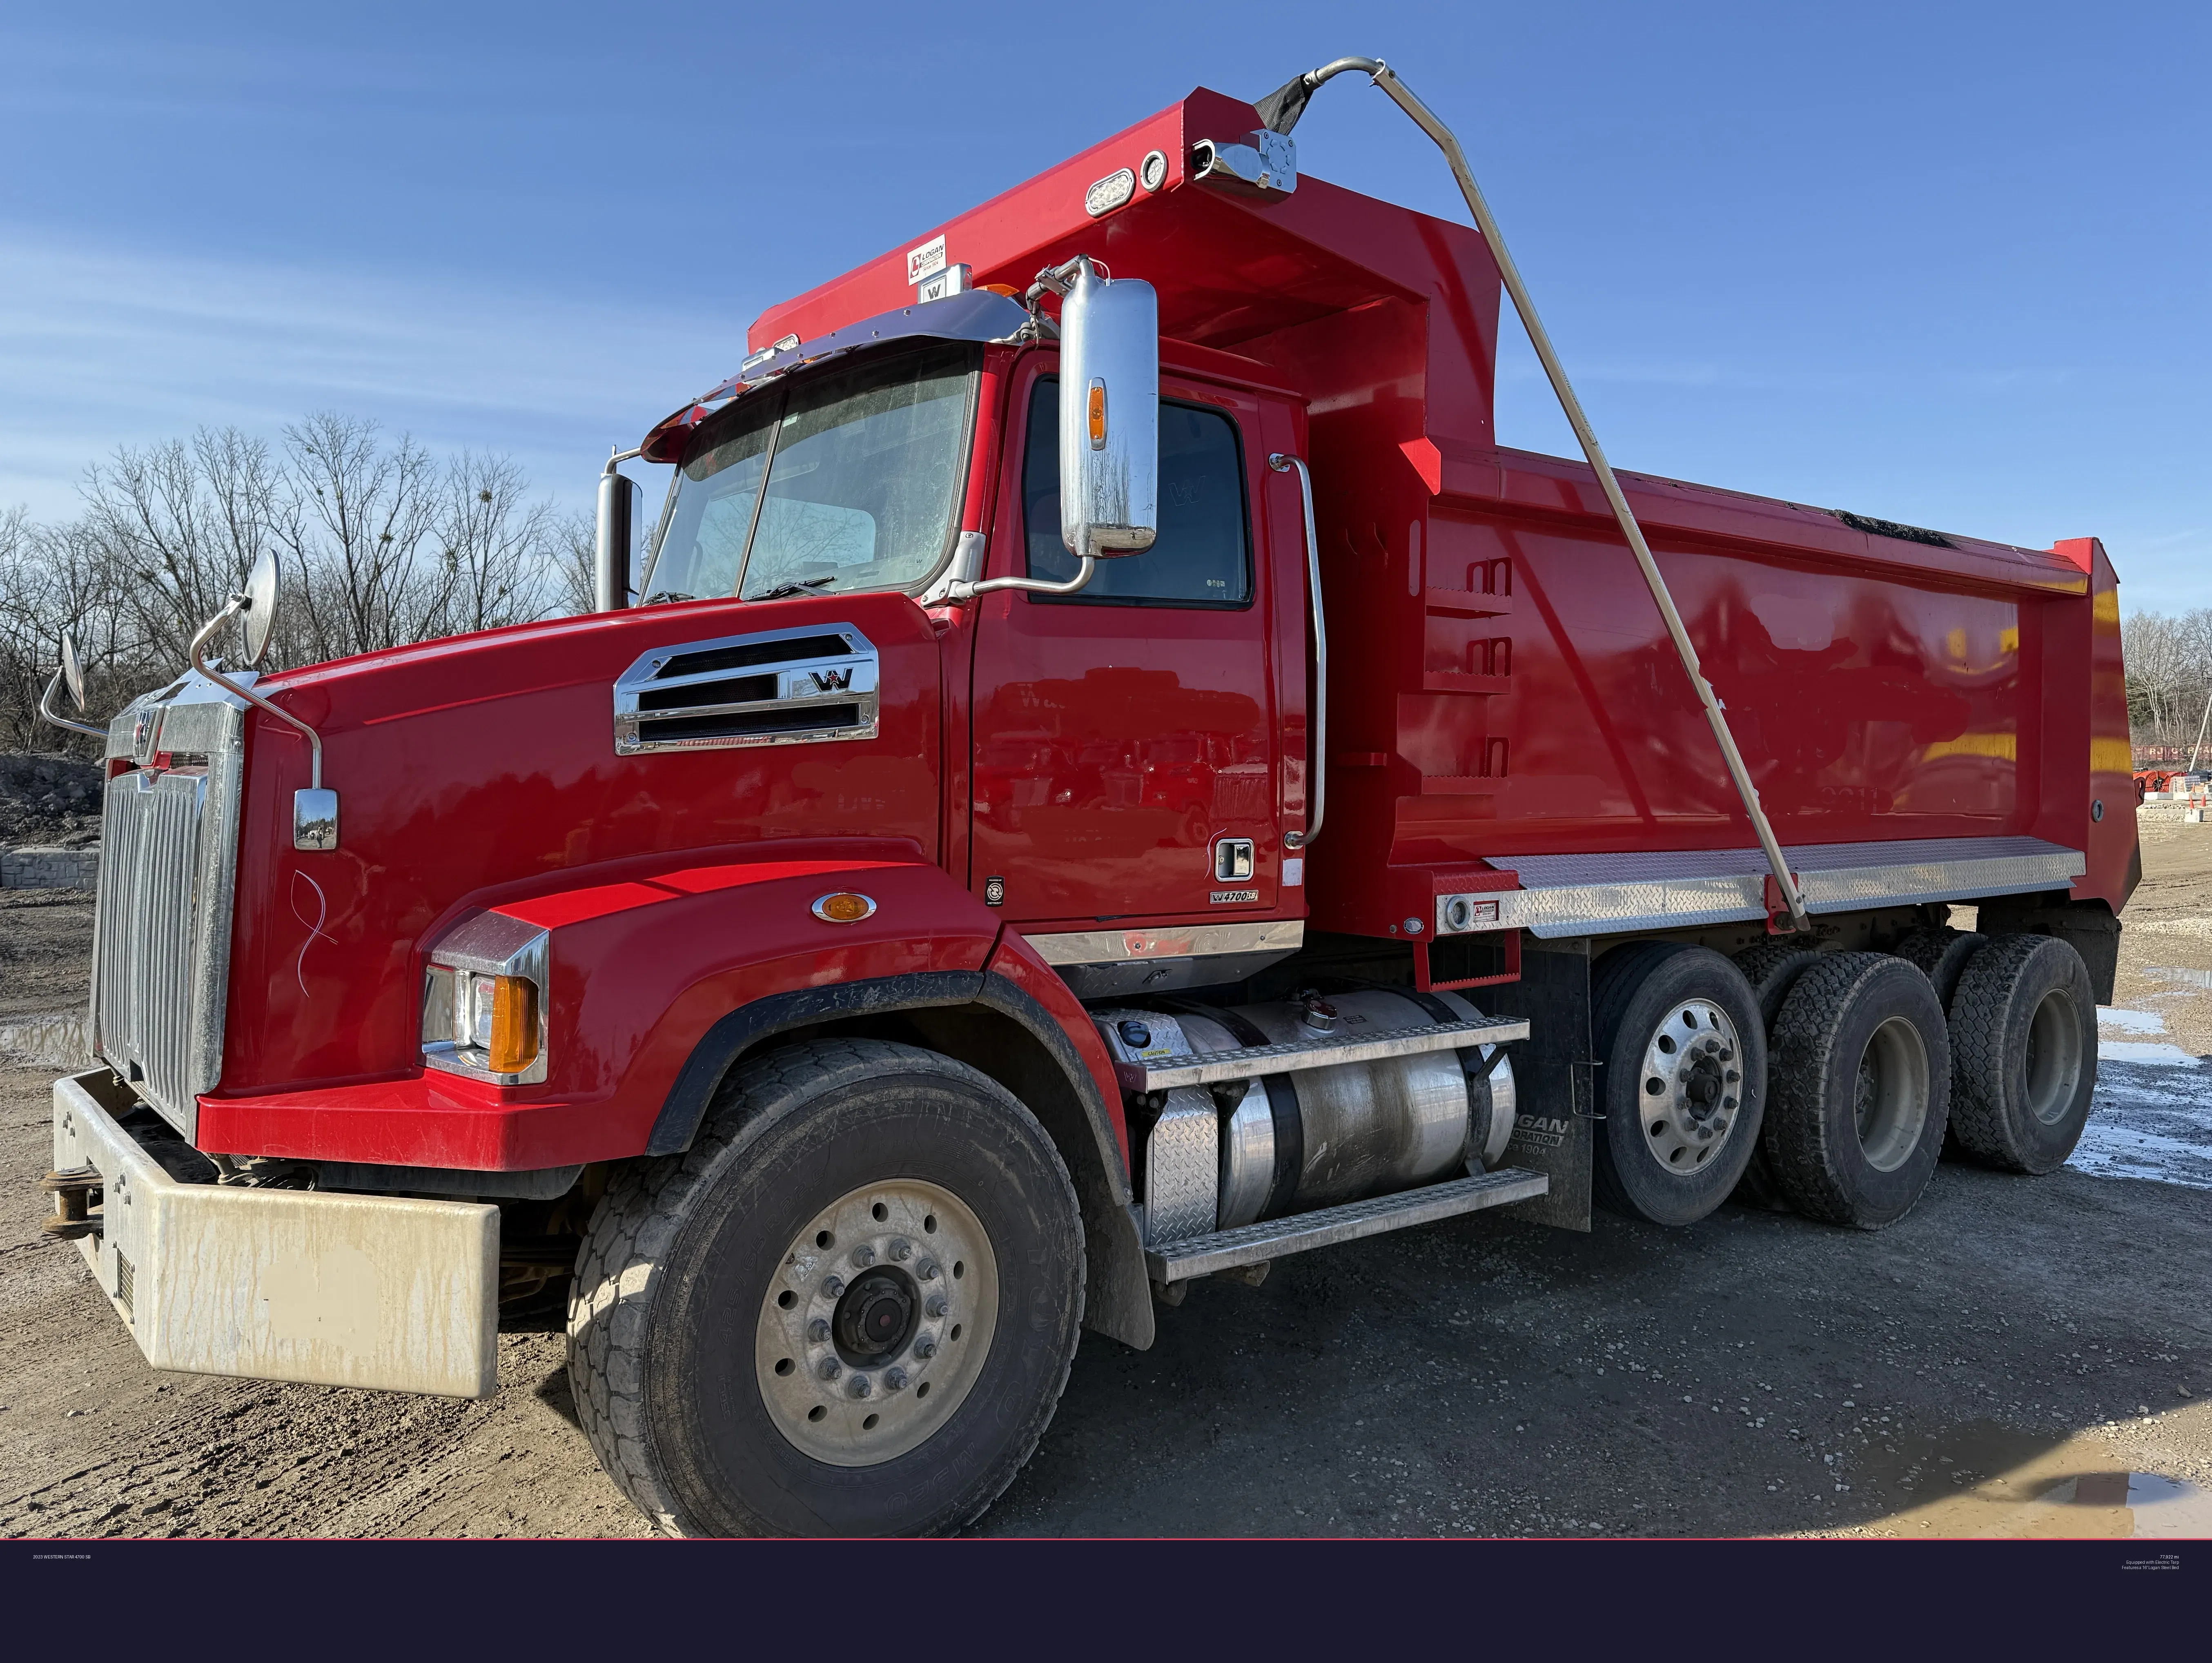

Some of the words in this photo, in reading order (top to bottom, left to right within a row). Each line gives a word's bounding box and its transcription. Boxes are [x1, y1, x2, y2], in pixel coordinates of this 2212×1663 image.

[922, 244, 944, 260] LOGAN
[1515, 1114, 1569, 1134] GAN
[1512, 1129, 1561, 1146] ORATION
[1521, 1144, 1546, 1157] 1904
